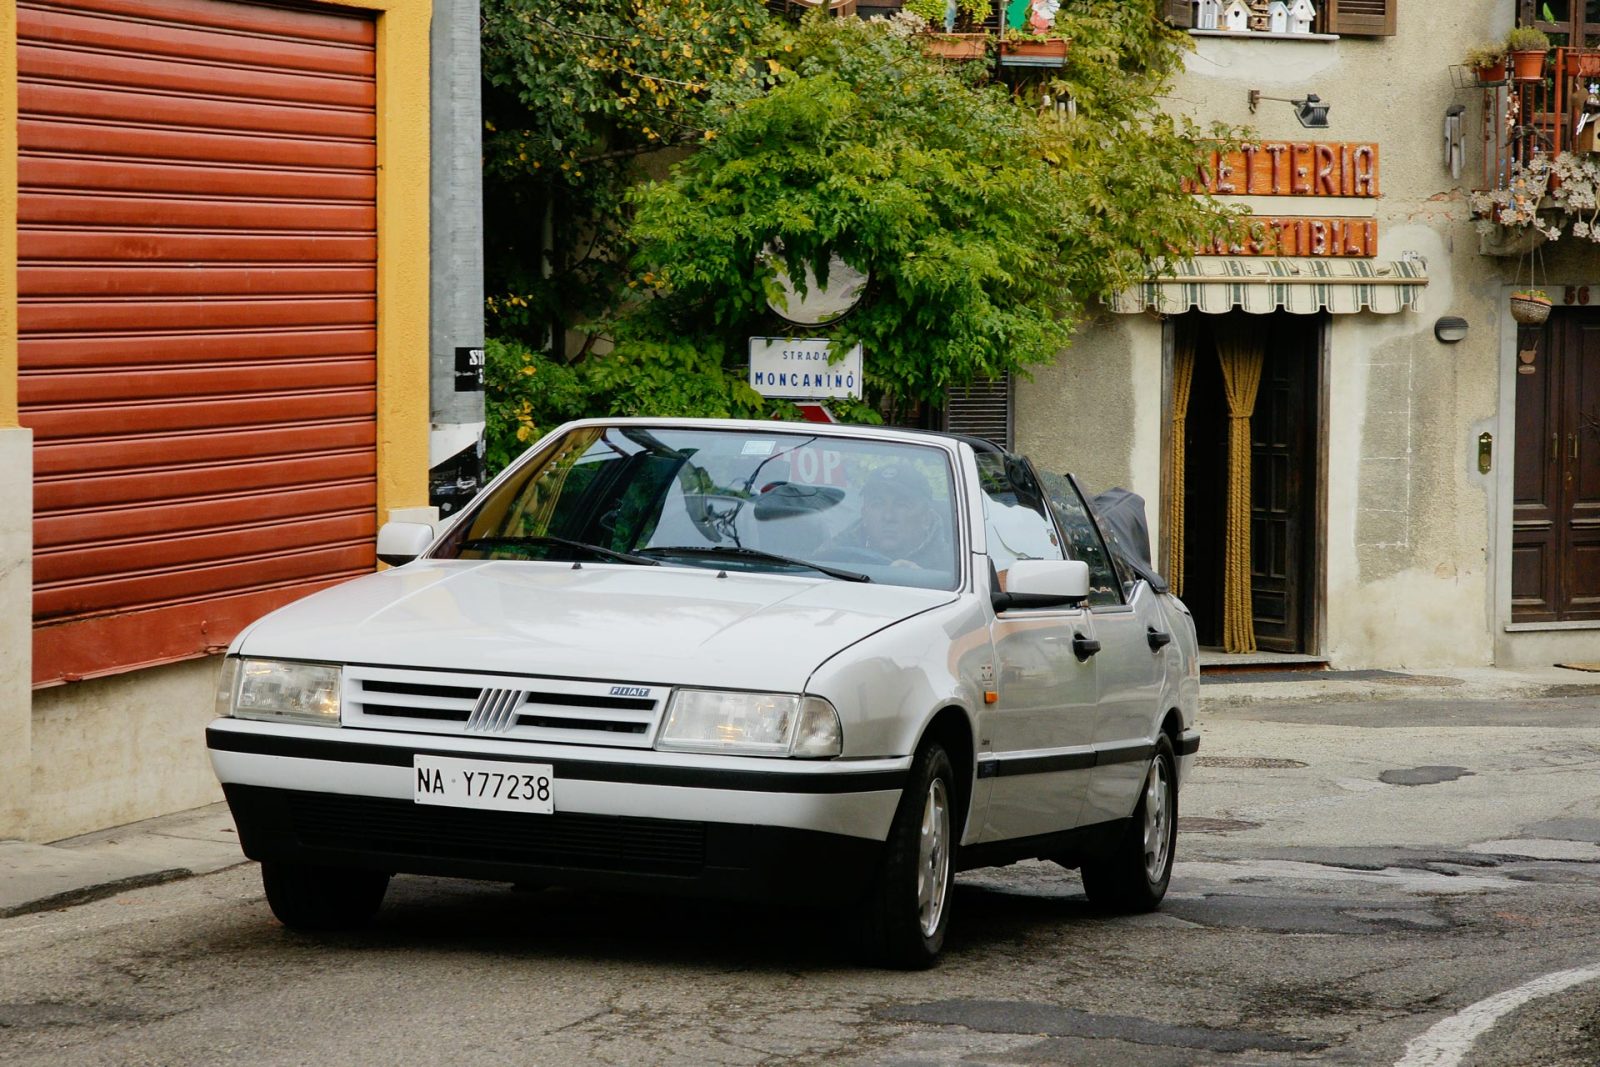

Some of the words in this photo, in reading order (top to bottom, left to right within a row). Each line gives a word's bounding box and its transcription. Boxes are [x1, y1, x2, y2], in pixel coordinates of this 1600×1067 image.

[783, 350, 827, 360] STRADA
[611, 687, 649, 697] FIAT
[417, 767, 444, 794] NA
[463, 771, 550, 801] Y77238
